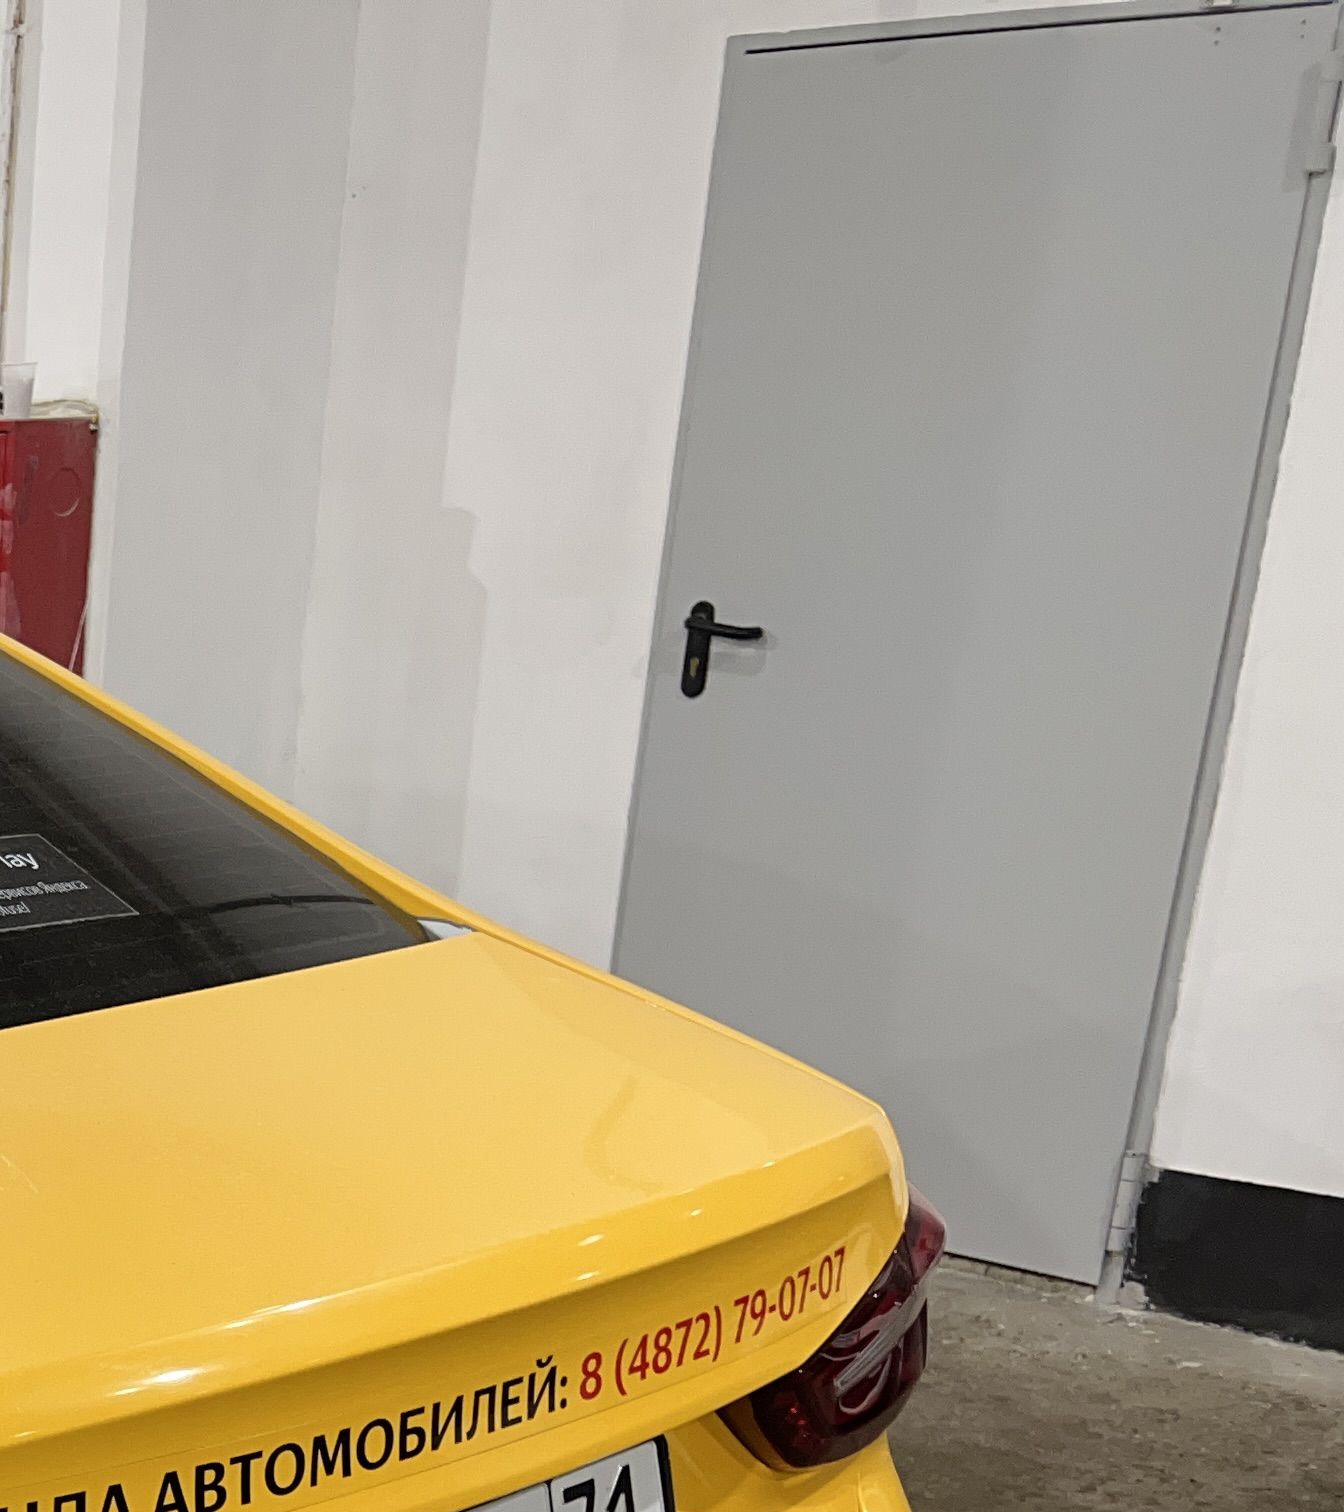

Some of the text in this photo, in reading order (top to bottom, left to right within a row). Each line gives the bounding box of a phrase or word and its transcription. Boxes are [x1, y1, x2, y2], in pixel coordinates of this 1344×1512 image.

[579, 1351, 603, 1401] 8
[614, 1305, 723, 1397] (4872)
[732, 1245, 847, 1345] 79-07-07
